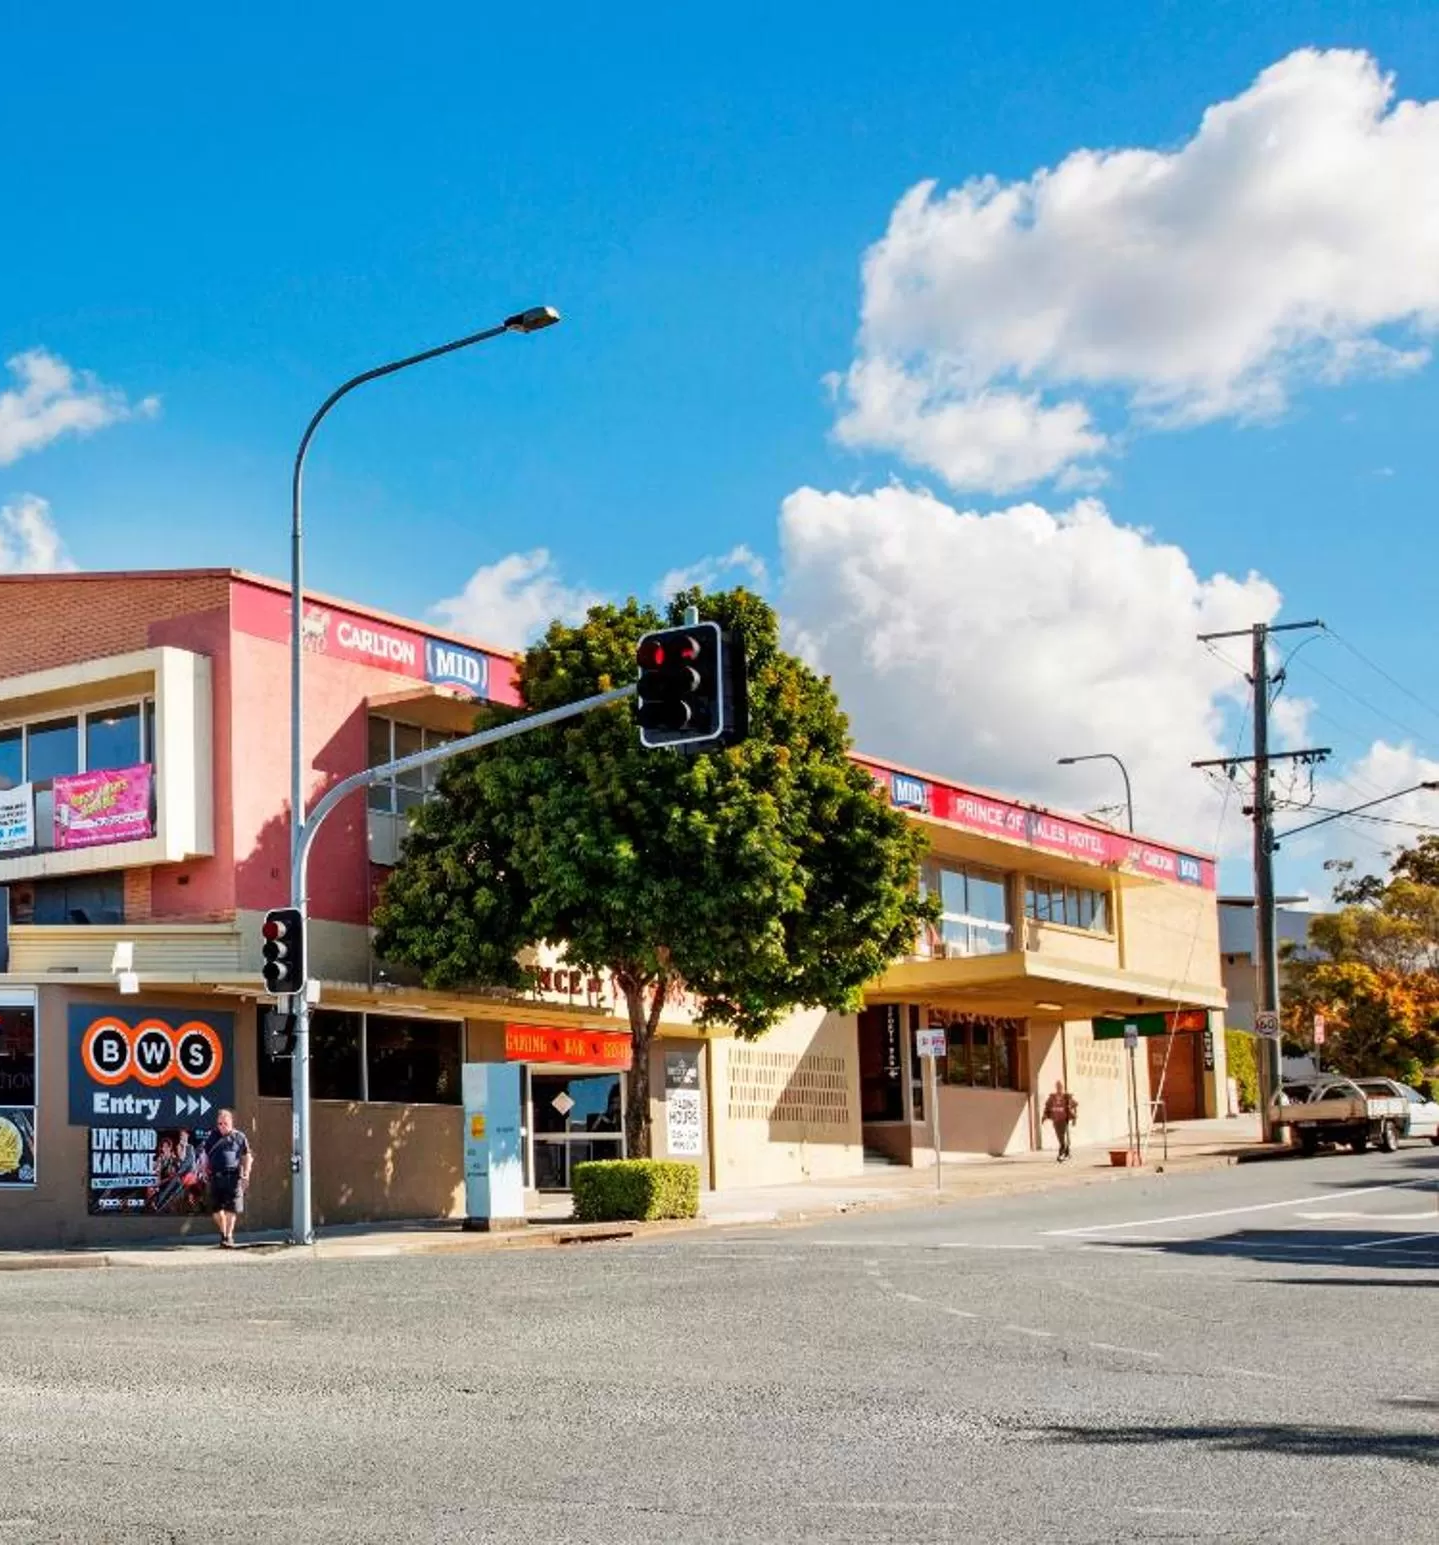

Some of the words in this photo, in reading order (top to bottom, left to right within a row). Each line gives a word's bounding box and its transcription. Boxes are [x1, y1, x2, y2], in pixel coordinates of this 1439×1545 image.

[337, 621, 415, 664] CARLTON
[435, 648, 480, 684] MID
[896, 780, 922, 803] MID
[957, 798, 1004, 825] PRINCE
[1007, 812, 1024, 831] OF
[1068, 830, 1105, 854] HOTEL
[102, 1040, 204, 1066] BWS
[93, 1092, 161, 1120] Entry
[92, 1128, 120, 1150] LIVE
[122, 1128, 157, 1150] BAND
[93, 1152, 157, 1174] KARAOKE
